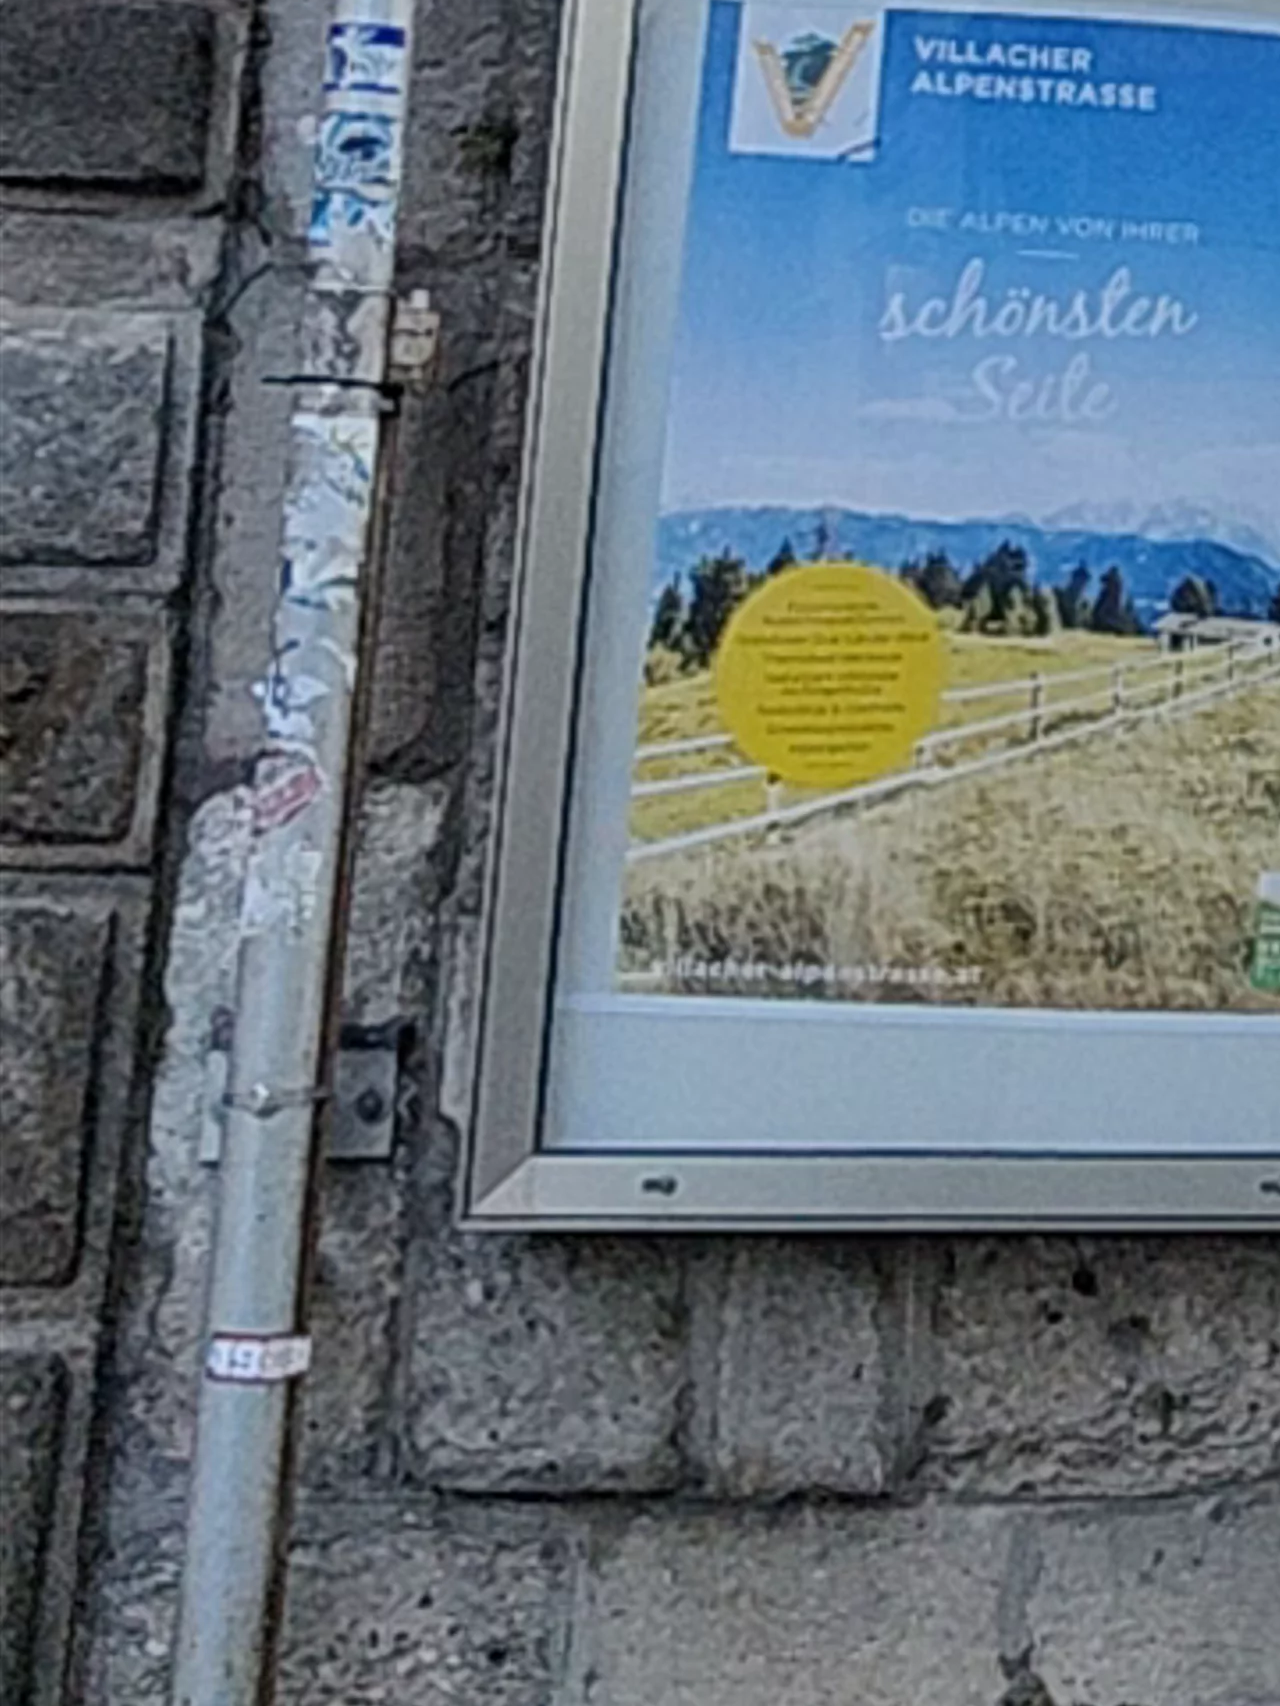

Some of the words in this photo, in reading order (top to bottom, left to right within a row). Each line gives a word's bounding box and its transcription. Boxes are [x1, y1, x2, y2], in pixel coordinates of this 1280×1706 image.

[913, 35, 1093, 73] VILLACHER
[910, 70, 1157, 111] ALPENSTRASSE
[907, 206, 949, 227] DIE
[958, 210, 1050, 235] ALPEN
[1054, 216, 1112, 239] VON
[878, 257, 1199, 341] schönsten
[954, 352, 1118, 421] Seite
